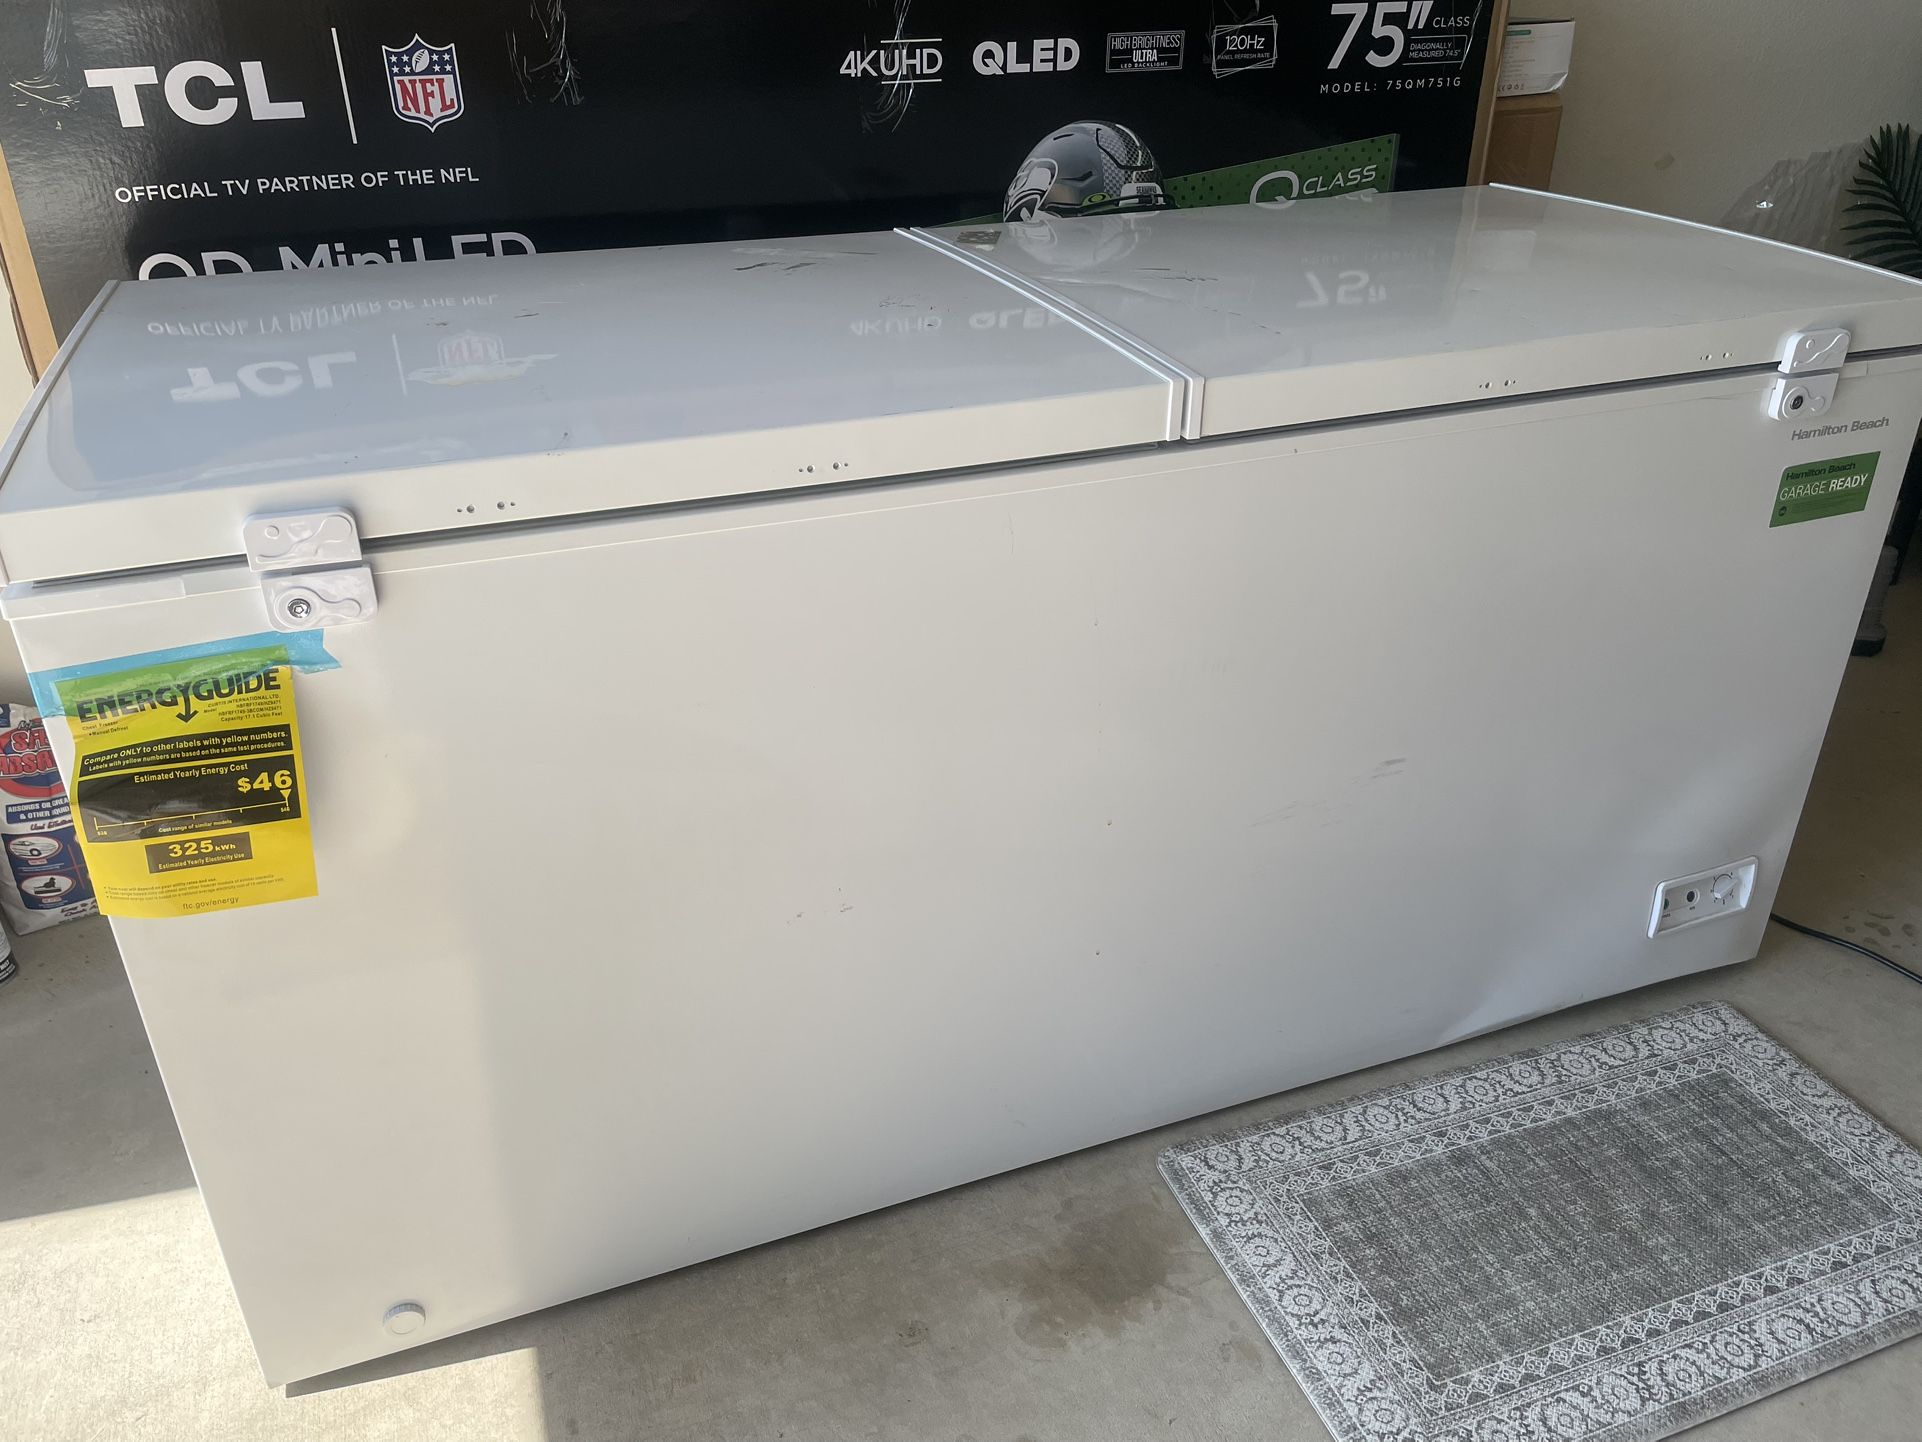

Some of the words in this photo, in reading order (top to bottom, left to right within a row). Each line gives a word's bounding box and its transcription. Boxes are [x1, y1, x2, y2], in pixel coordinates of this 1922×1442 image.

[1432, 16, 1471, 28] CLASS
[1111, 36, 1131, 50] HIGH
[1132, 34, 1181, 49] BRIGHTNESS
[1225, 34, 1265, 50] 120Hz
[1410, 42, 1452, 51] DIAGONALLY
[972, 38, 1080, 76] QLED
[1132, 49, 1158, 63] ULTRA
[1408, 50, 1445, 59] MEASURED
[84, 60, 306, 128] TCL
[1319, 81, 1378, 94] MODEL:
[1386, 76, 1462, 90] 75QM751G
[396, 77, 457, 118] NFL
[115, 181, 218, 204] OFFICIAL
[222, 179, 249, 196] TV
[257, 172, 356, 194] PARTNER
[360, 171, 389, 189] OF
[394, 168, 435, 186] THE
[440, 166, 479, 183] NFL
[1250, 170, 1300, 205] Q
[1303, 164, 1378, 195] CLASS
[1791, 424, 1848, 441] Hamilton
[1850, 416, 1890, 432] Beach
[1785, 467, 1826, 481] Hamilton
[1827, 462, 1856, 474] Beach
[1779, 481, 1828, 501] GARAGE
[1828, 473, 1869, 492] READY
[77, 668, 281, 723] ENERGYGUIDE
[84, 753, 118, 765] Compare
[120, 747, 142, 757] ONLY
[152, 743, 174, 752] other
[176, 739, 201, 749] labels
[202, 736, 221, 746] with
[222, 734, 249, 745] yellow
[250, 731, 289, 741] numbers.
[89, 763, 108, 771] Labels
[122, 757, 141, 766] yellow
[142, 754, 170, 762] numbers
[181, 750, 200, 758] based
[251, 741, 286, 751] procedures.
[134, 771, 174, 783] Estimated
[174, 768, 200, 779] Yearly
[201, 766, 229, 776] Energy
[229, 763, 248, 772] Cost
[237, 769, 293, 793] $46
[28, 810, 50, 819] OTHER
[168, 839, 214, 858] 325
[215, 843, 236, 852] kWh
[158, 862, 187, 870] Estimated
[187, 858, 205, 866] Yearly
[205, 854, 233, 863] Electricity
